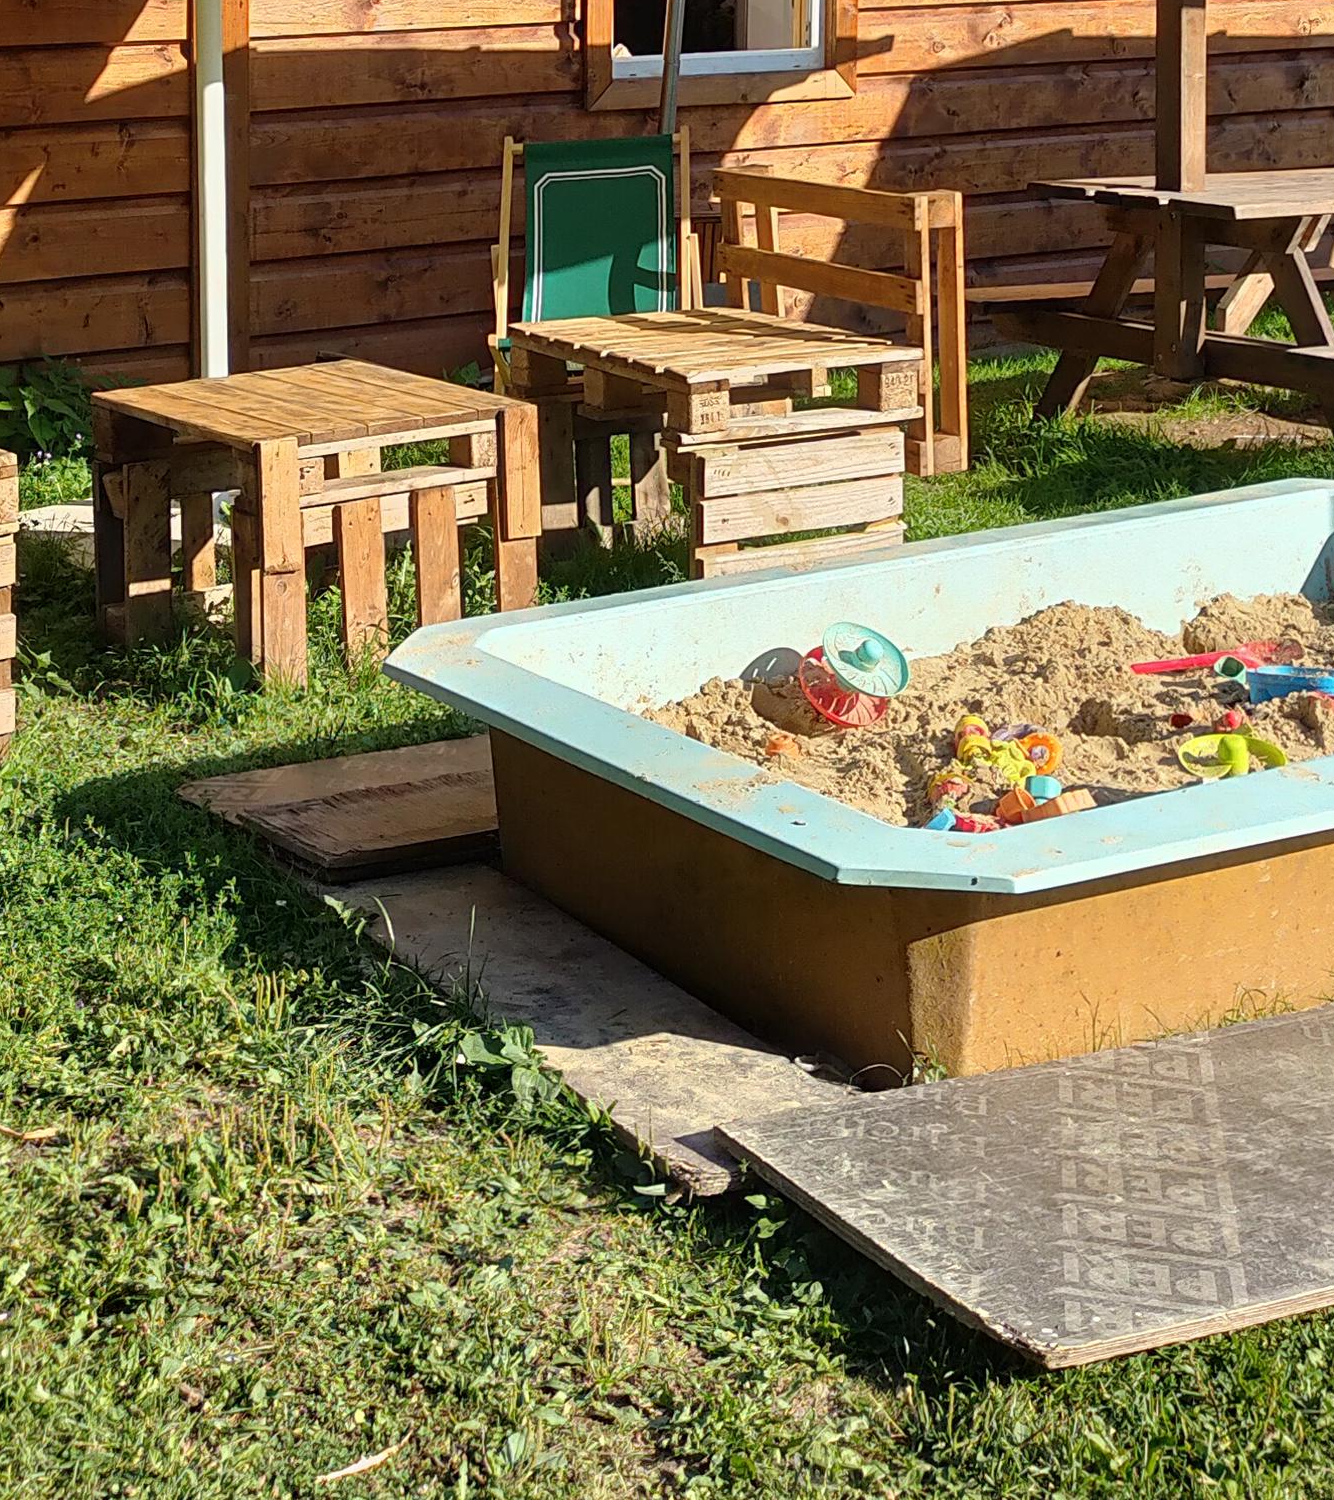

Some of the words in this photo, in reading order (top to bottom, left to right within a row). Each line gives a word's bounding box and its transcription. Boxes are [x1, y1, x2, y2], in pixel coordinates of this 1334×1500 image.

[1060, 1158, 1208, 1211] PERI
[1062, 1202, 1214, 1253] PERI
[1063, 1252, 1219, 1303] PERI
